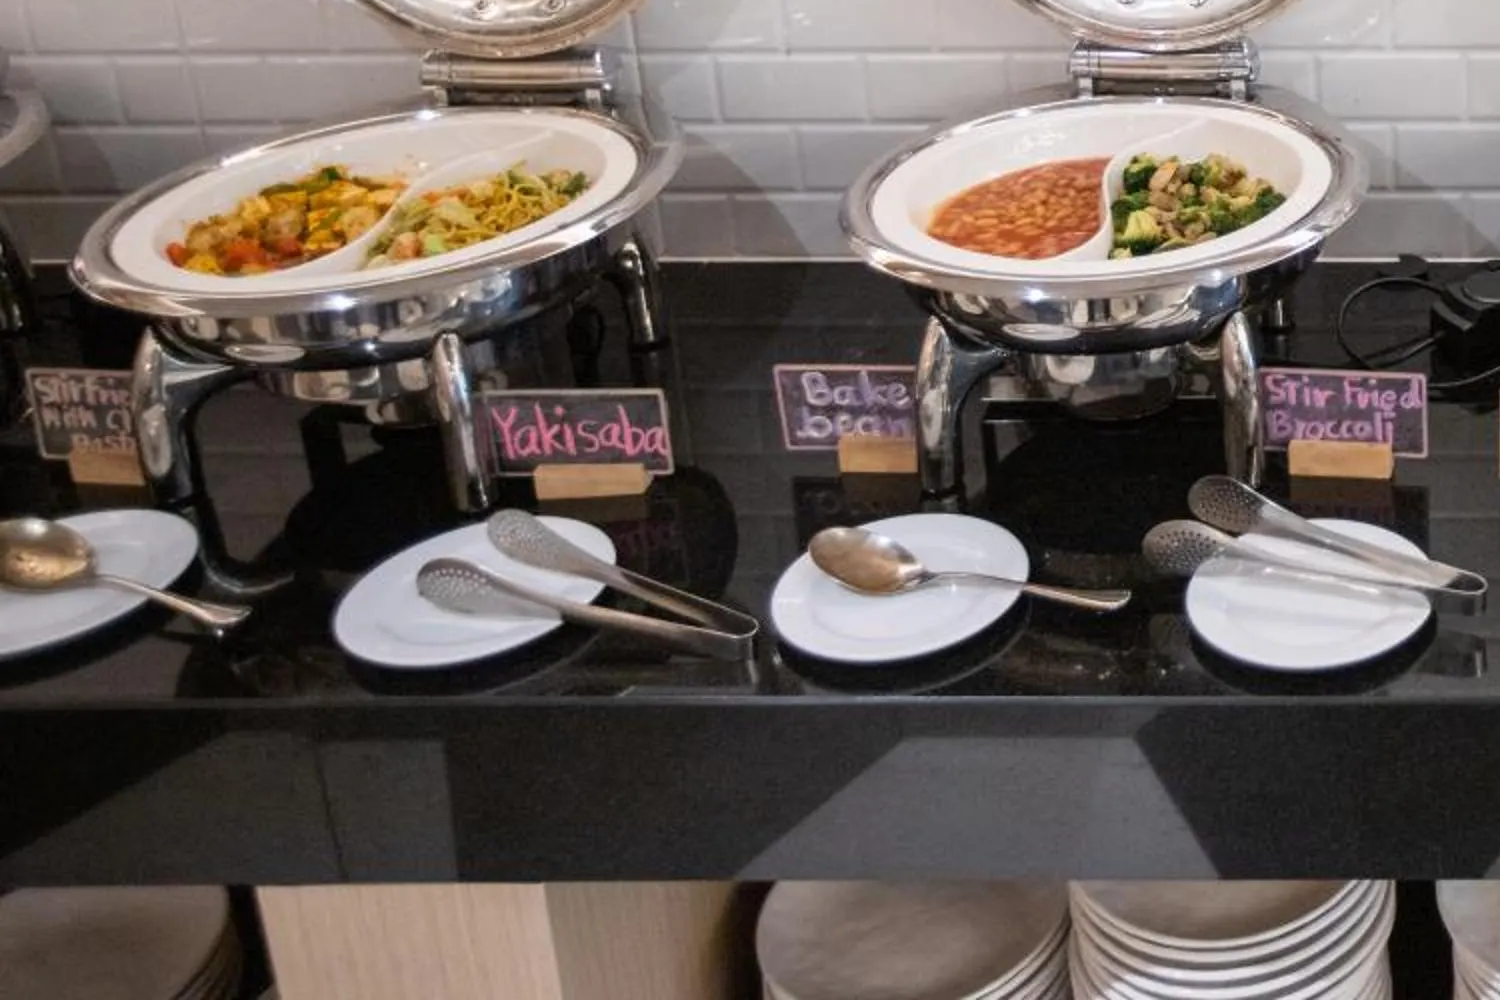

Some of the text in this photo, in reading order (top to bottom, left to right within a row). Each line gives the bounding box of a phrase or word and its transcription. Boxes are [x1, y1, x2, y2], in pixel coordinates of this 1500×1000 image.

[1265, 373, 1335, 408] Stir
[491, 401, 668, 461] Yakisaba
[1266, 408, 1396, 443] Broccoli
